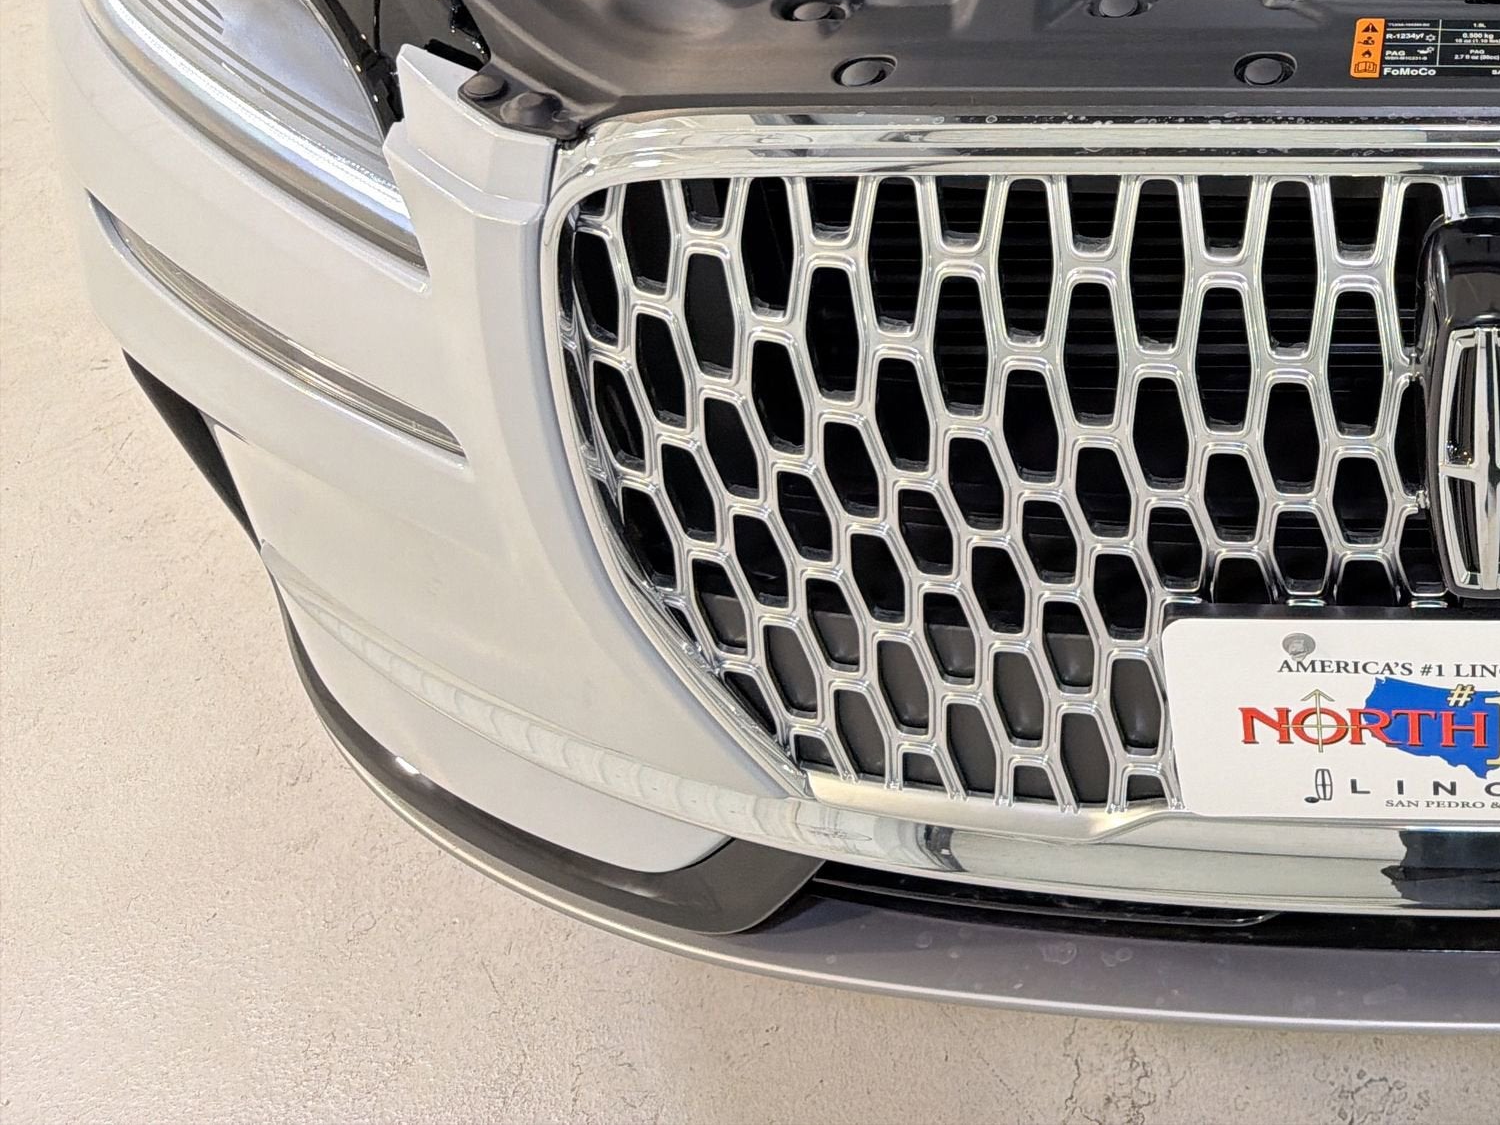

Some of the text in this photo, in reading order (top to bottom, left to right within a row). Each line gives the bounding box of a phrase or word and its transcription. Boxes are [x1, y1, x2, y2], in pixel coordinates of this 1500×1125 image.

[1484, 32, 1495, 40] kg
[1383, 67, 1437, 76] FoMoCo
[1277, 659, 1413, 676] AMERICA'S
[1420, 663, 1445, 677] #1
[1238, 706, 1489, 748] NORTH
[1385, 799, 1419, 809] SAN
[1425, 800, 1485, 810] PEDRO
